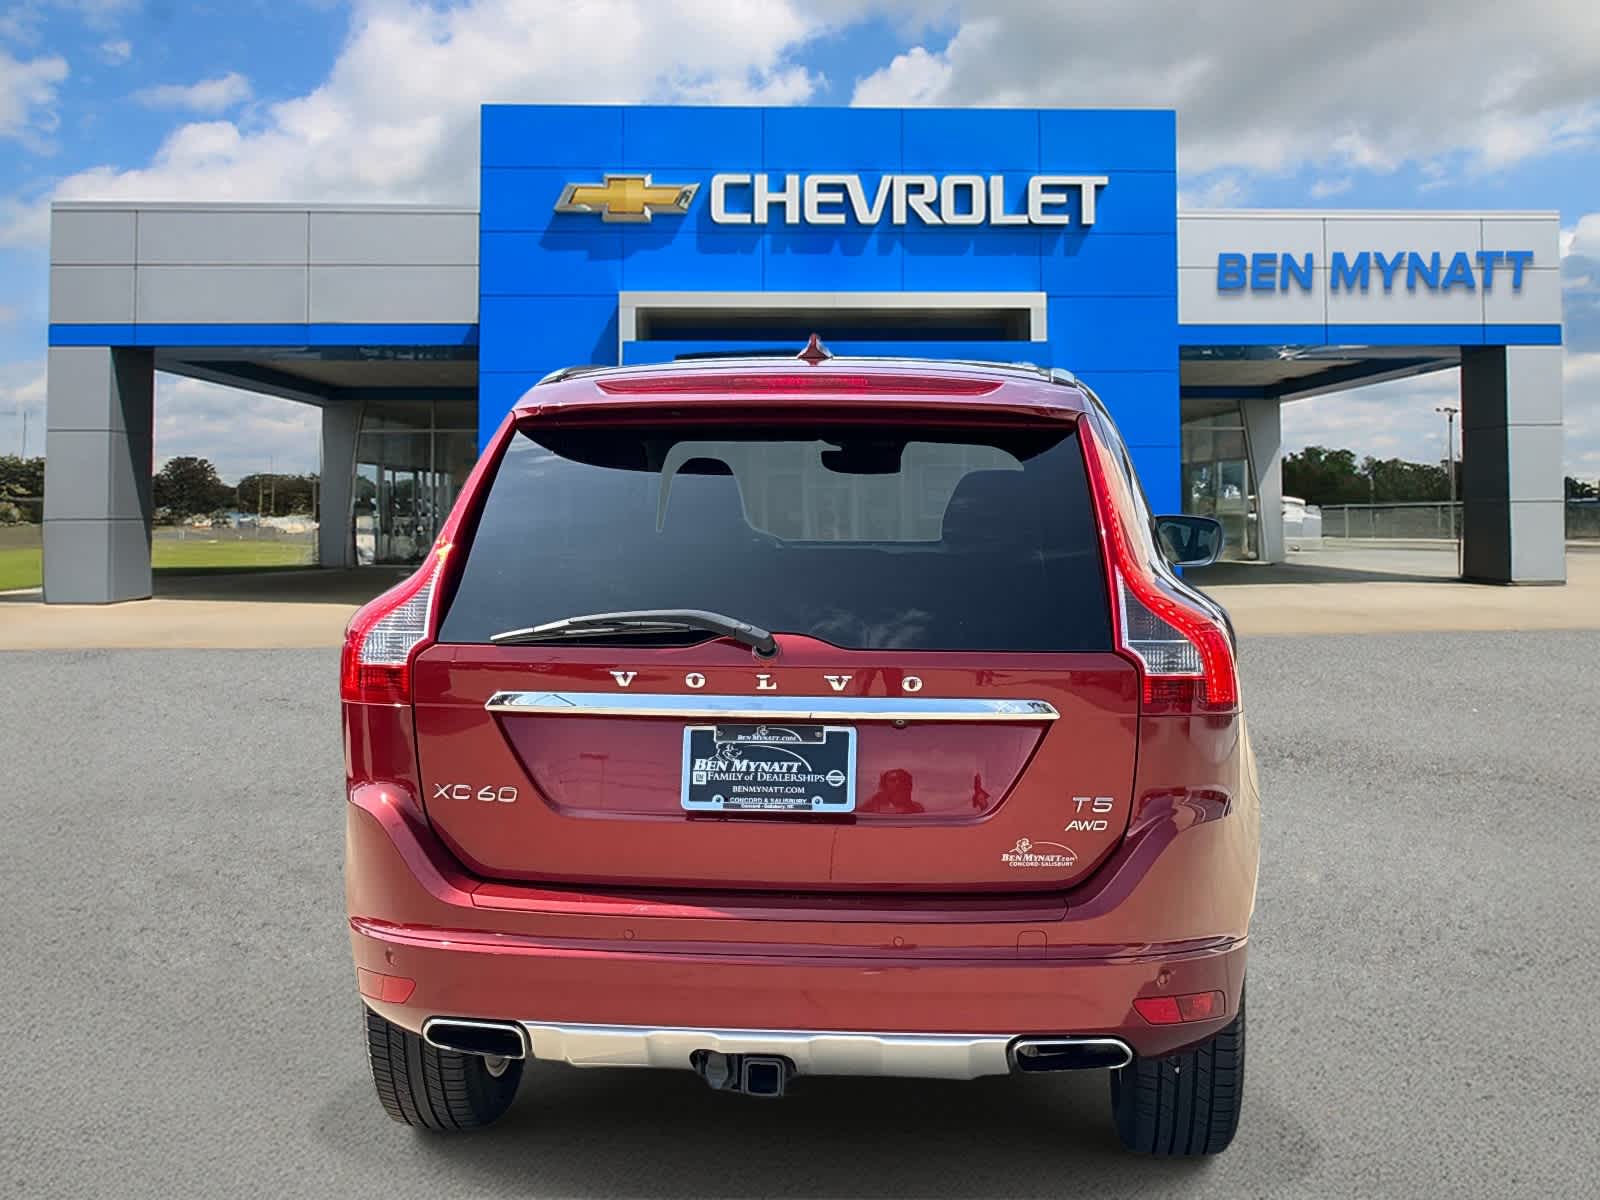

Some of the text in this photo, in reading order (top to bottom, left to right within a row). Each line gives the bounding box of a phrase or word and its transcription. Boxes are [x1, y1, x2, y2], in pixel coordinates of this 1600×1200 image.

[710, 173, 1109, 226] CHEVROLET
[1217, 250, 1534, 291] BEN MYNATT
[609, 670, 923, 693] VOLVO
[693, 758, 802, 773] BEN MYNATT
[707, 771, 744, 781] FAMILY
[757, 772, 825, 783] DEALERSHIPS
[732, 785, 806, 794] BENMYNATT.COM
[1072, 797, 1114, 813] T5
[1064, 820, 1108, 831] AWD
